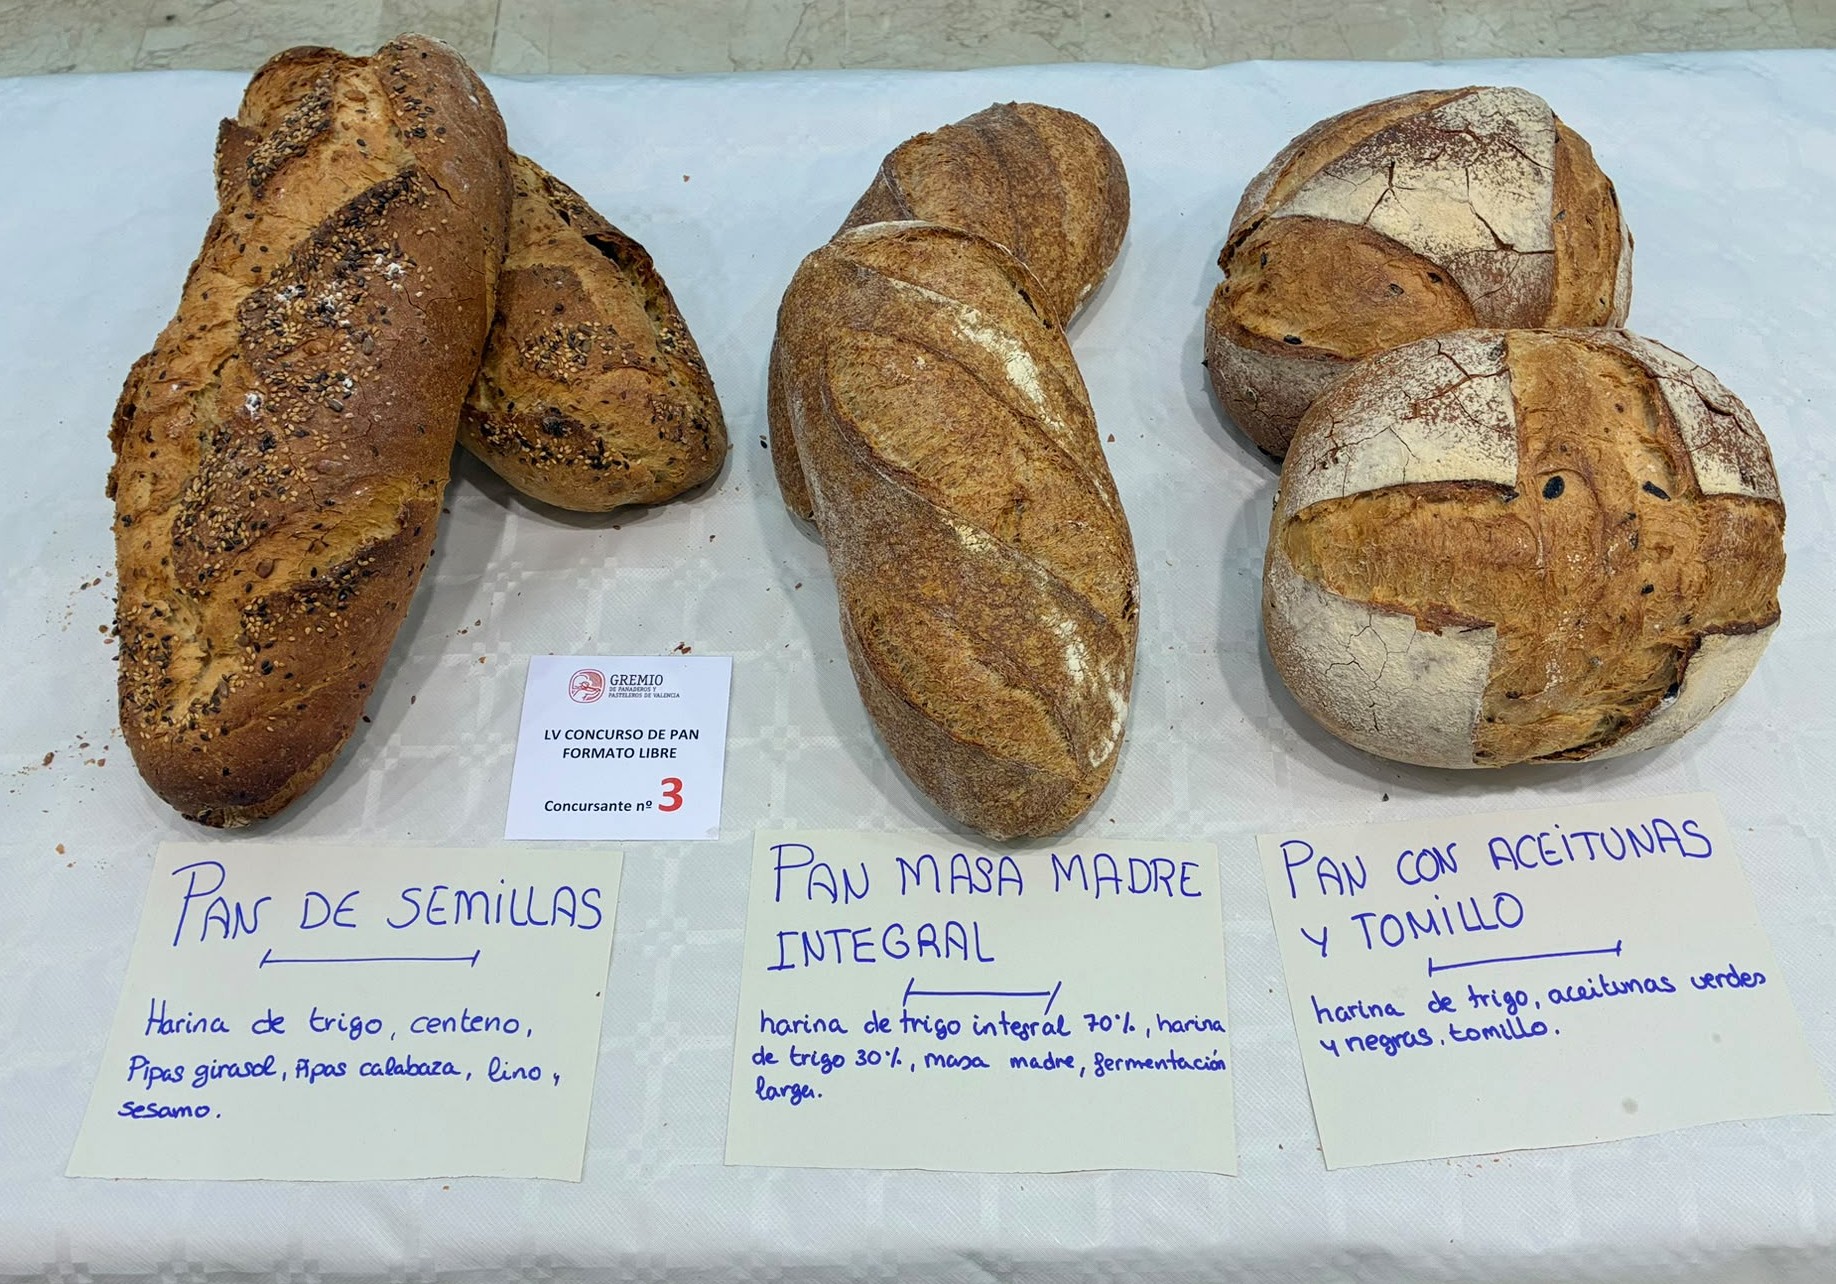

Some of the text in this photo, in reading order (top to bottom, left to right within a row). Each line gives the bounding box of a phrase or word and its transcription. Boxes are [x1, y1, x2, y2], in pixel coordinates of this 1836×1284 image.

[610, 674, 663, 686] GREMIO
[545, 729, 699, 740] LV CONCURSO DE PAN
[563, 748, 676, 758] FORMATO LIBRE
[545, 801, 631, 811] Concursante
[659, 778, 683, 812] 3
[770, 844, 1201, 904] PAN MASA MADRE
[1280, 840, 1366, 898] PAN
[1397, 843, 1457, 885] CON
[172, 861, 271, 946] PAN
[300, 891, 359, 929] DE
[767, 921, 994, 971] INTEGRAL
[1311, 964, 1766, 1024] harina de trigo, aceitunas verdes
[145, 998, 531, 1040] Harina de trigo, centeno,
[761, 1010, 848, 1036] harina
[864, 1010, 891, 1034] de
[900, 1009, 961, 1040] trigo
[973, 1014, 1071, 1041] integral
[1157, 1014, 1225, 1033] harina
[752, 1047, 779, 1065] de
[790, 1047, 845, 1074] trigo
[924, 1053, 990, 1070] masa
[1010, 1051, 1085, 1078] madre,
[1094, 1049, 1226, 1077] fermentación
[1320, 1040, 1340, 1057] y
[128, 1055, 184, 1090] Pipas
[296, 1059, 346, 1084] Pipas
